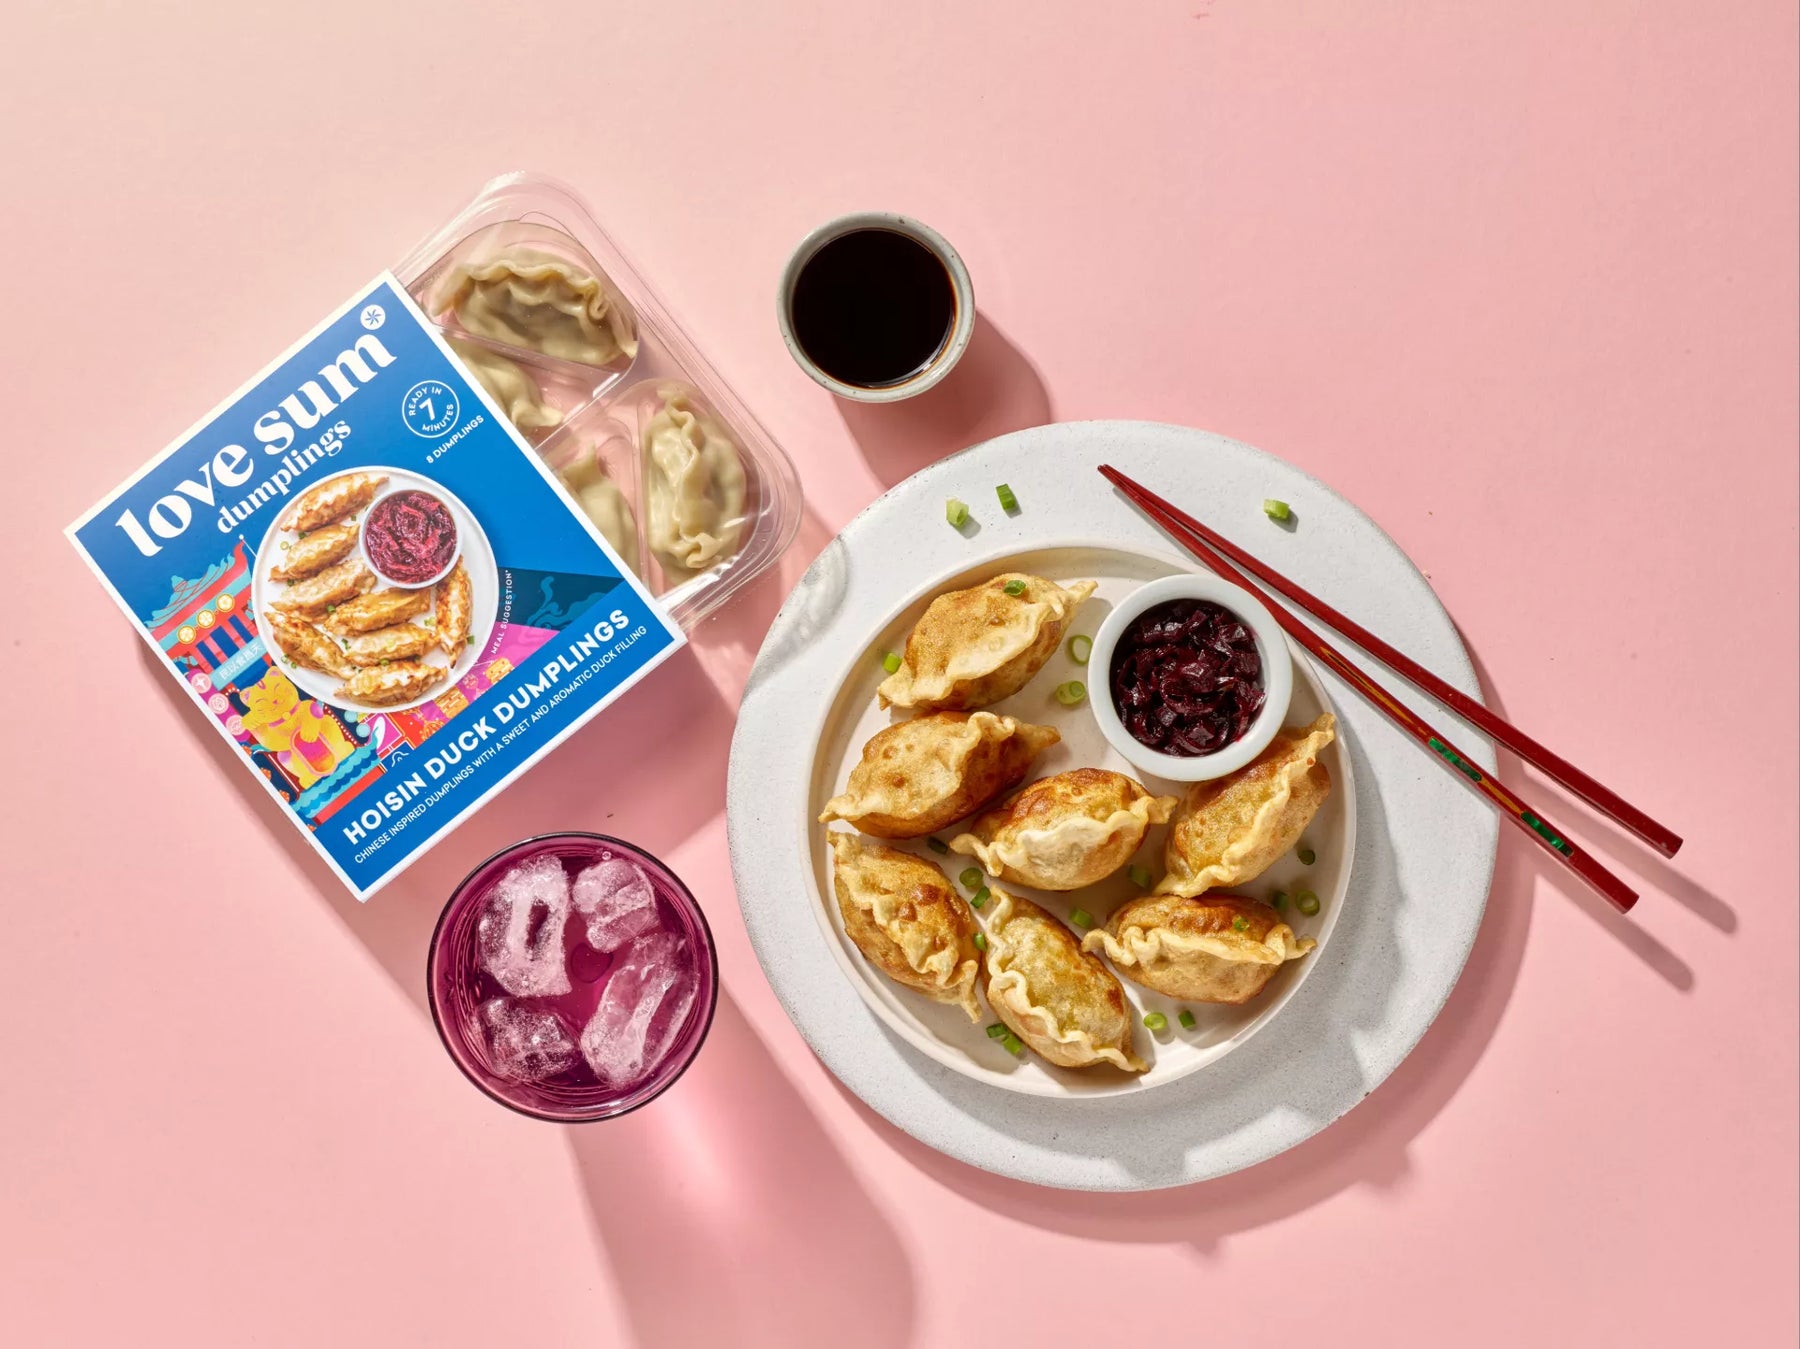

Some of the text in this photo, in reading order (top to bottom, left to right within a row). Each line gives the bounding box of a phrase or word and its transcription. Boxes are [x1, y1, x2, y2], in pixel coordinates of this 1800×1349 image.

[408, 386, 442, 416] READY IN
[419, 397, 435, 421] 7
[422, 404, 454, 432] MINUTES
[115, 334, 397, 557] love sum
[426, 415, 484, 463] 8 DUMPLINGS
[217, 420, 351, 533] dumplings
[491, 632, 504, 654] MEAL
[342, 609, 629, 845] HOISIN DUCK DUMPLINGS
[354, 625, 647, 864] CHINESE INSPIRED DUMPLINGS WITH A SWEET AND AROMATIC DUCK FILLING
